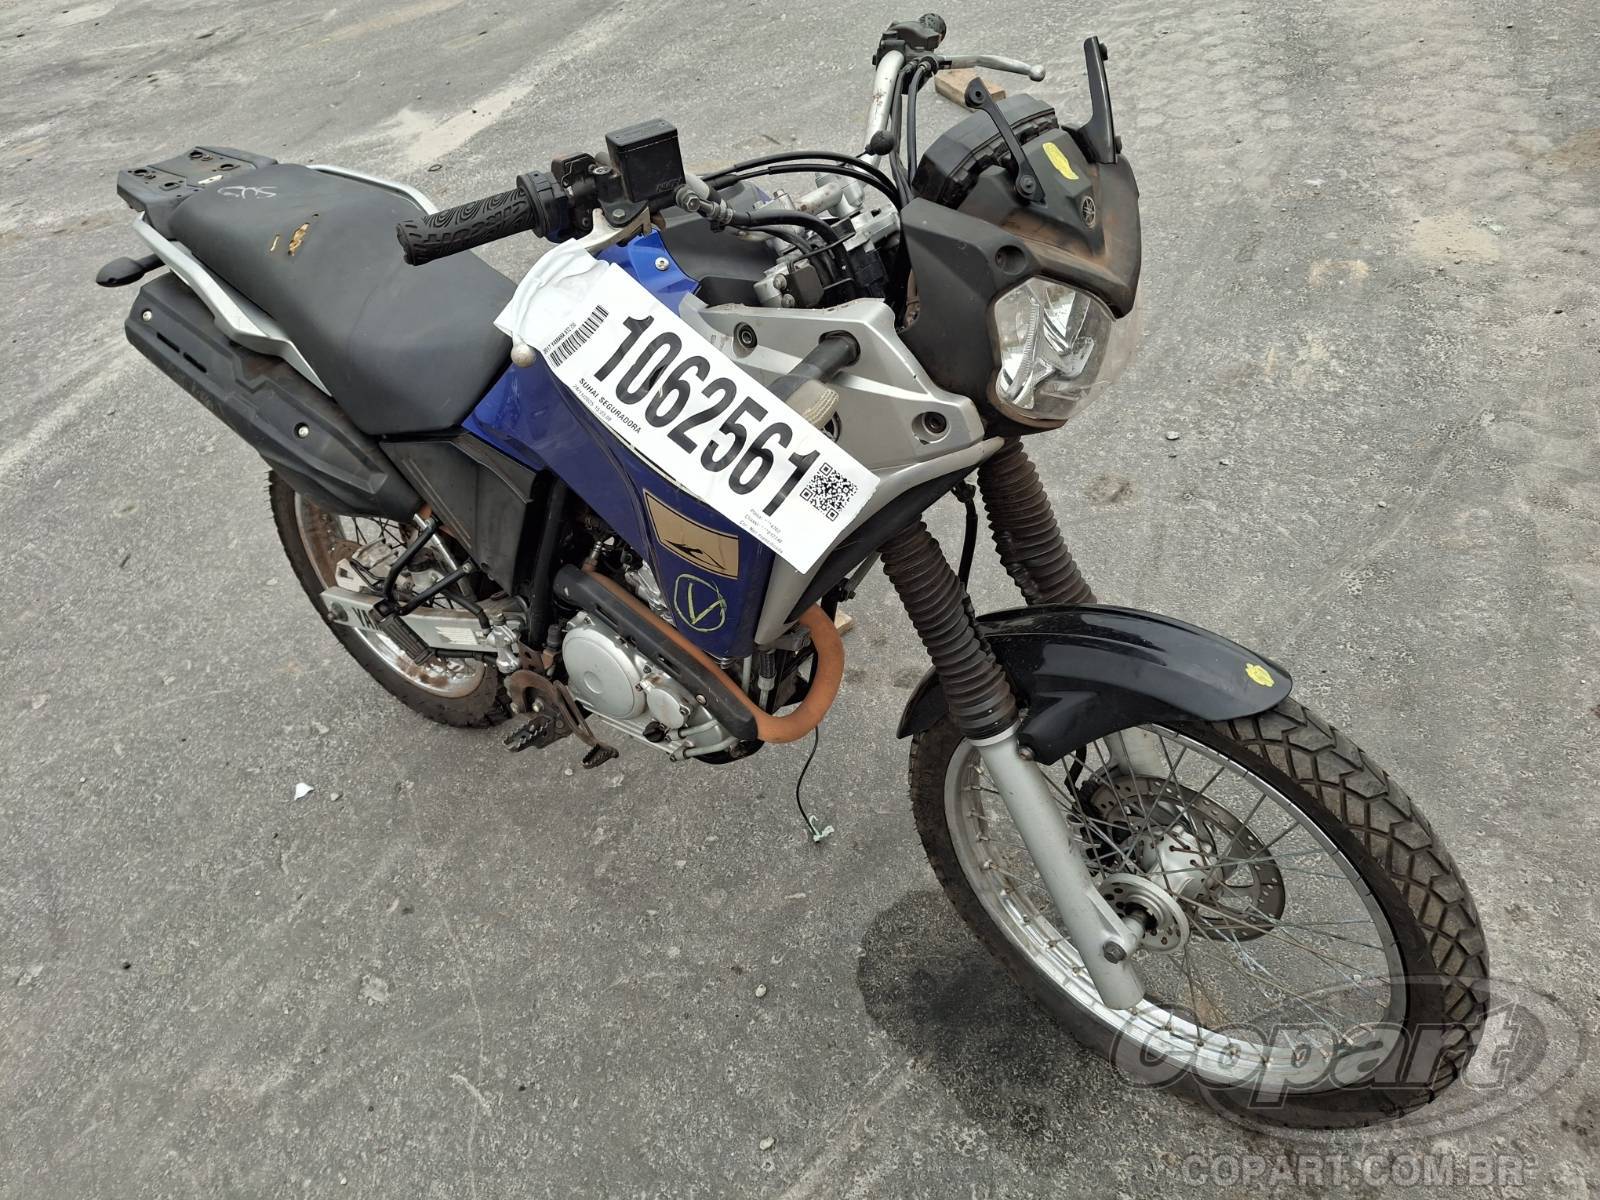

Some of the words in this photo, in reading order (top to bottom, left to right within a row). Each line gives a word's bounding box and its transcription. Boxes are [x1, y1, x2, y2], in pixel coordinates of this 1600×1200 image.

[579, 377, 600, 398] SUHAI
[598, 396, 642, 434] SEGURADORA
[594, 315, 820, 517] 1062561
